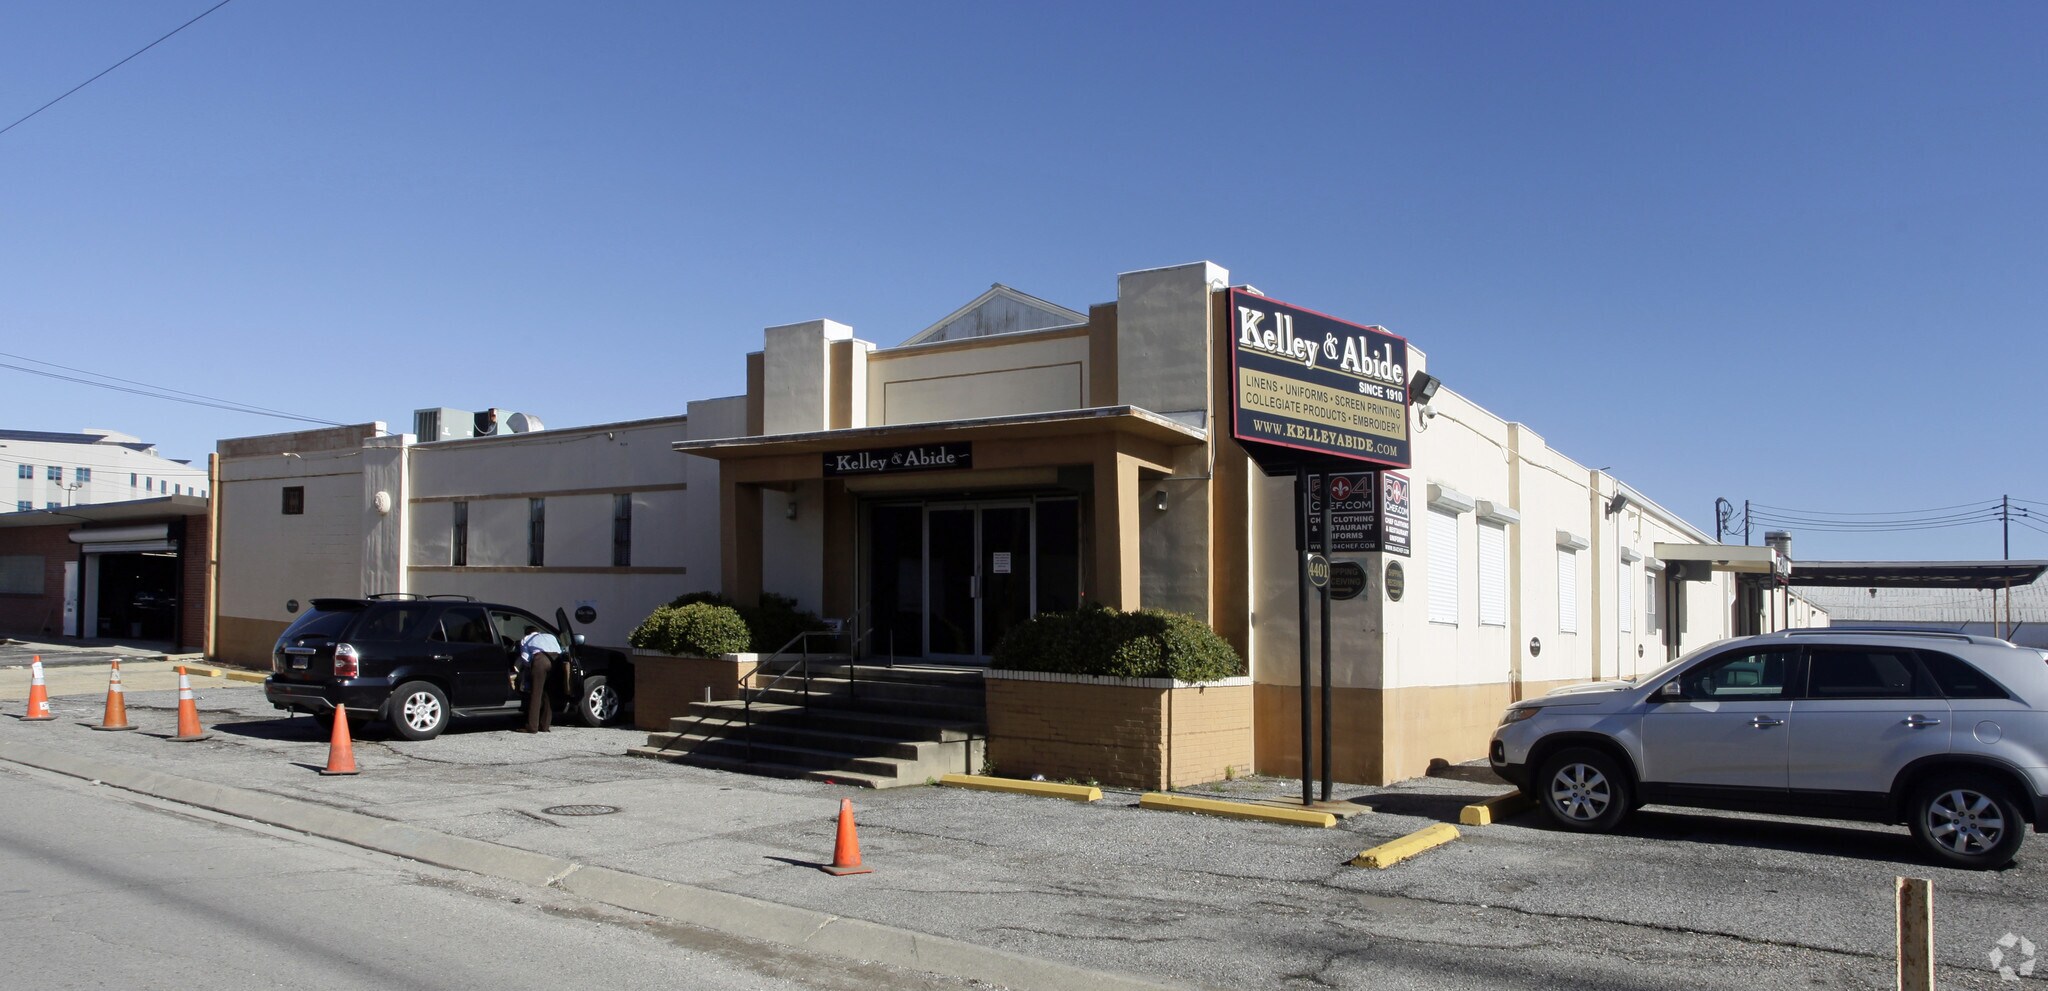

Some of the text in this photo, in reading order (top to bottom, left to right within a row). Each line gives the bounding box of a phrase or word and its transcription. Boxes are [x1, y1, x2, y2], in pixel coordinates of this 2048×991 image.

[1238, 306, 1404, 385] Kelley & Abide
[1246, 375, 1401, 419] LINENS UNIFORMS SCREEN PRINTING
[1359, 382, 1403, 403] SINCE 1910
[1246, 392, 1401, 434] COLLEGIATE PRODUCTS EMBROIDERY
[1253, 419, 1397, 457] WWW.KELLEYABIDE.COM
[836, 446, 955, 471] Kelley & Abide
[1311, 500, 1372, 511] CEF.COM
[1331, 523, 1373, 531] STAURANT
[1333, 515, 1374, 523] CLOTHING
[1309, 562, 1328, 578] 4401
